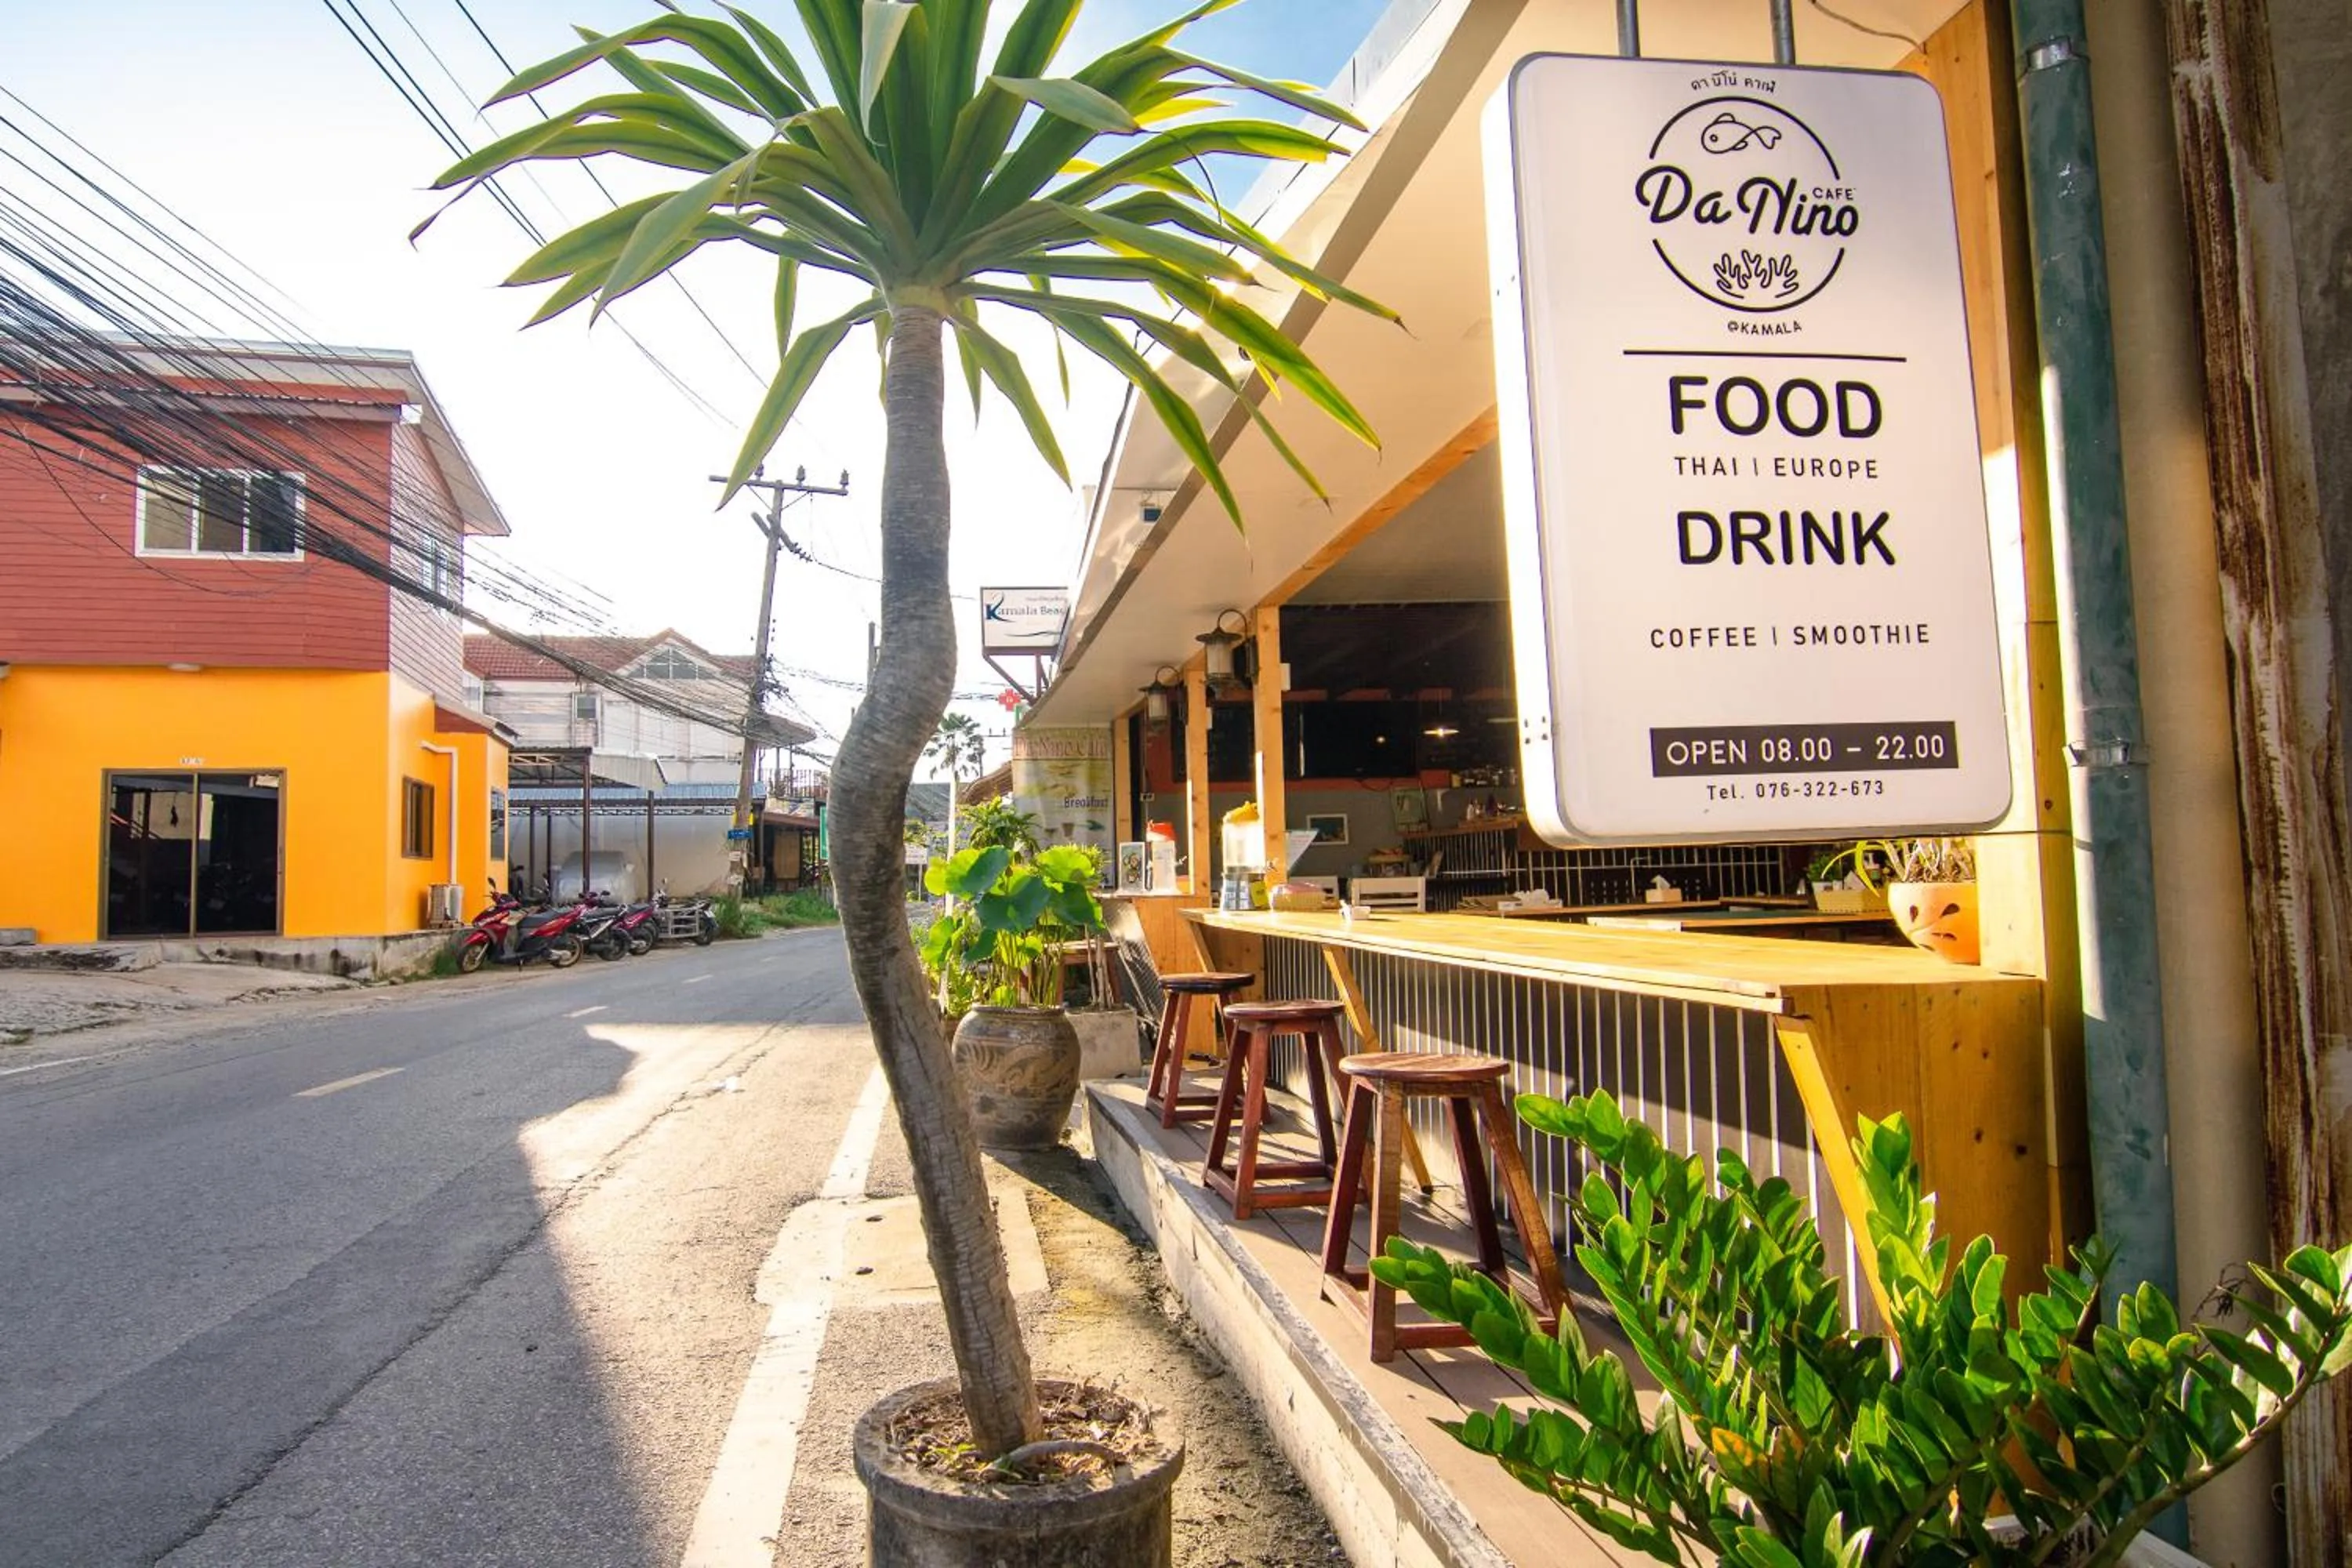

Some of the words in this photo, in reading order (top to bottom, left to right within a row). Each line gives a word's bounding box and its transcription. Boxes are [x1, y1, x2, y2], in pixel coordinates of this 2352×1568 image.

[1635, 165, 1732, 225] Da
[1737, 176, 1860, 237] Nino
[1727, 320, 1802, 336] @KAMALA
[1668, 376, 1882, 438] FOOD
[1674, 456, 1738, 476] THAI
[1773, 457, 1878, 479] EUROPE
[1677, 510, 1896, 565] DRINK
[1650, 626, 1757, 648] COFFEE
[1793, 623, 1930, 645] SMOOTHIE
[1666, 739, 1748, 765] OPEN
[1761, 738, 1832, 763] 08.00
[1875, 735, 1945, 760] 22.00
[1707, 784, 1744, 800] Tel.
[1755, 780, 1884, 799] 076-322-673
